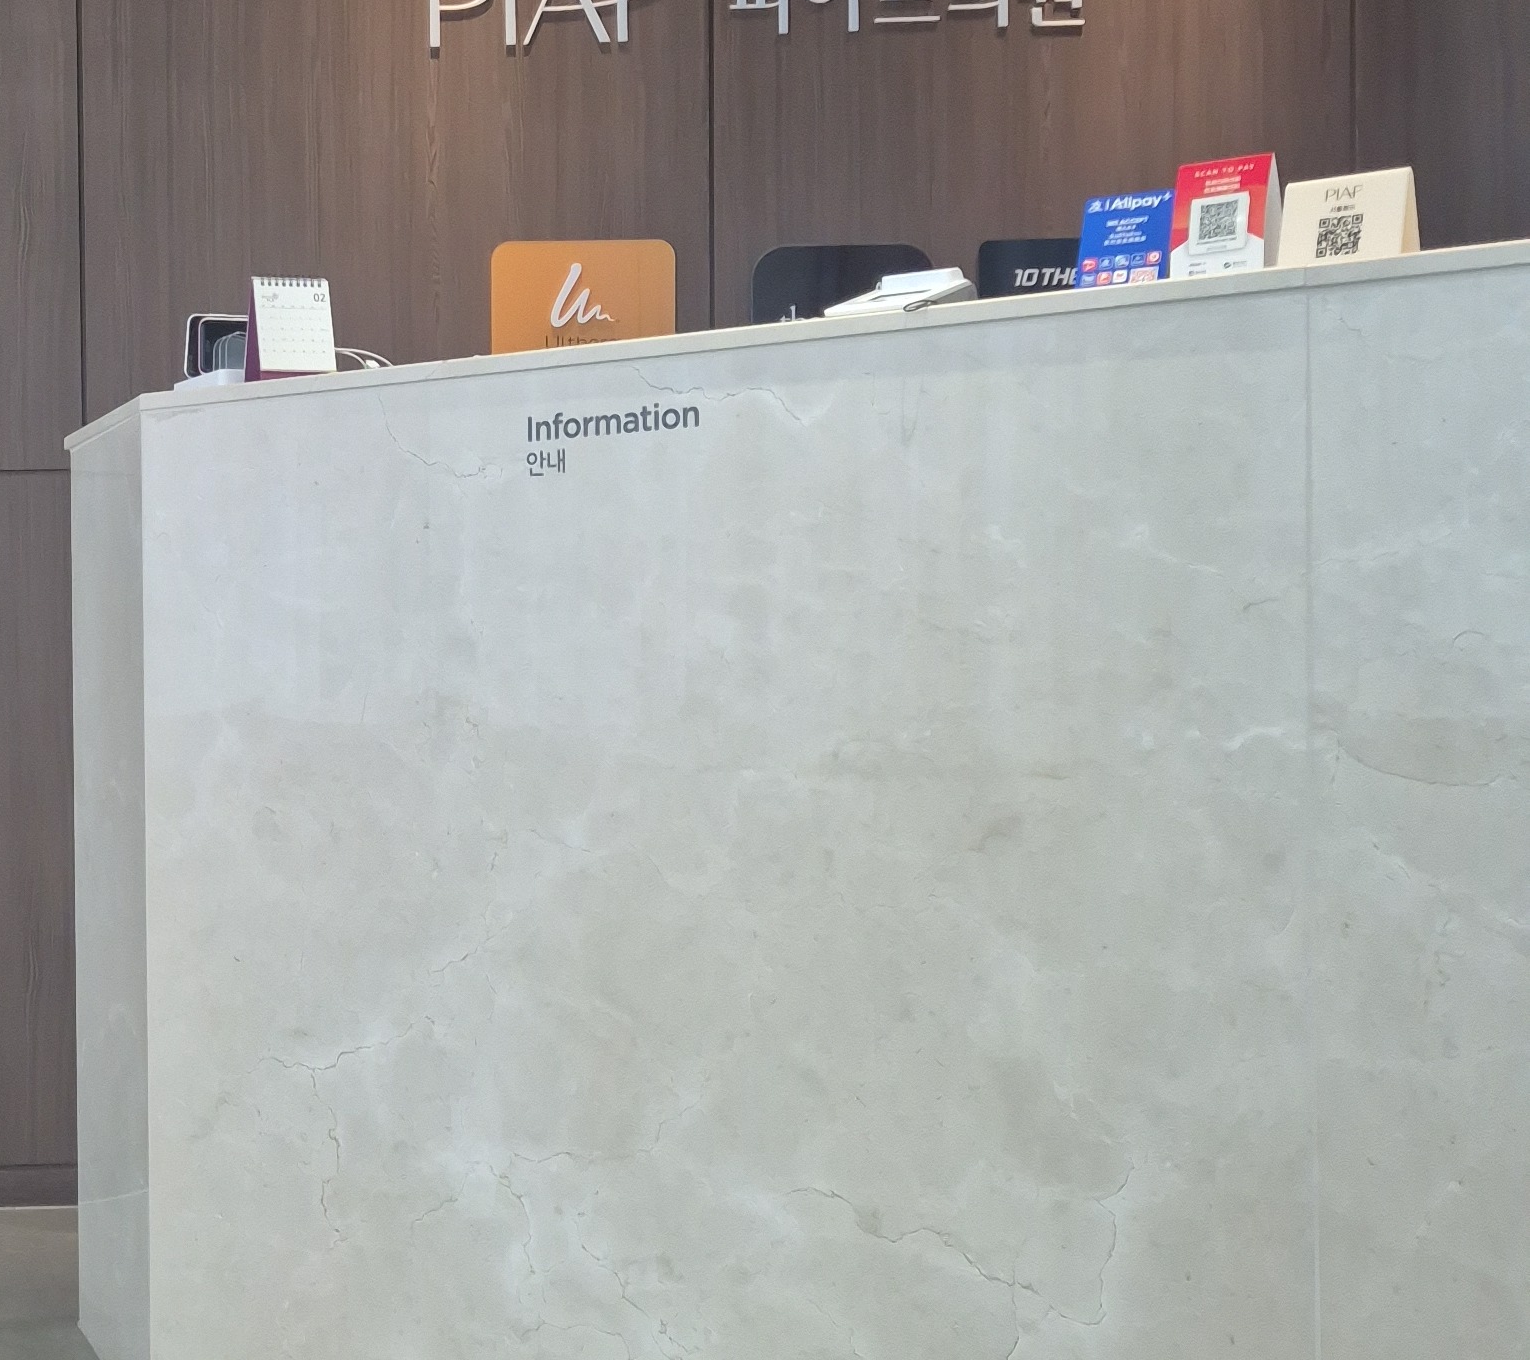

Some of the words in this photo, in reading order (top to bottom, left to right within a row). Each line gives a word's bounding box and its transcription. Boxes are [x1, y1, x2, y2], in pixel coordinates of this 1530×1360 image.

[1194, 168, 1219, 178] SCAN
[1222, 165, 1234, 174] TO
[1238, 163, 1255, 172] PAY
[1325, 184, 1363, 202] PIAF
[313, 293, 327, 303] 02
[526, 402, 700, 443] Information
[526, 448, 566, 477] 안내
